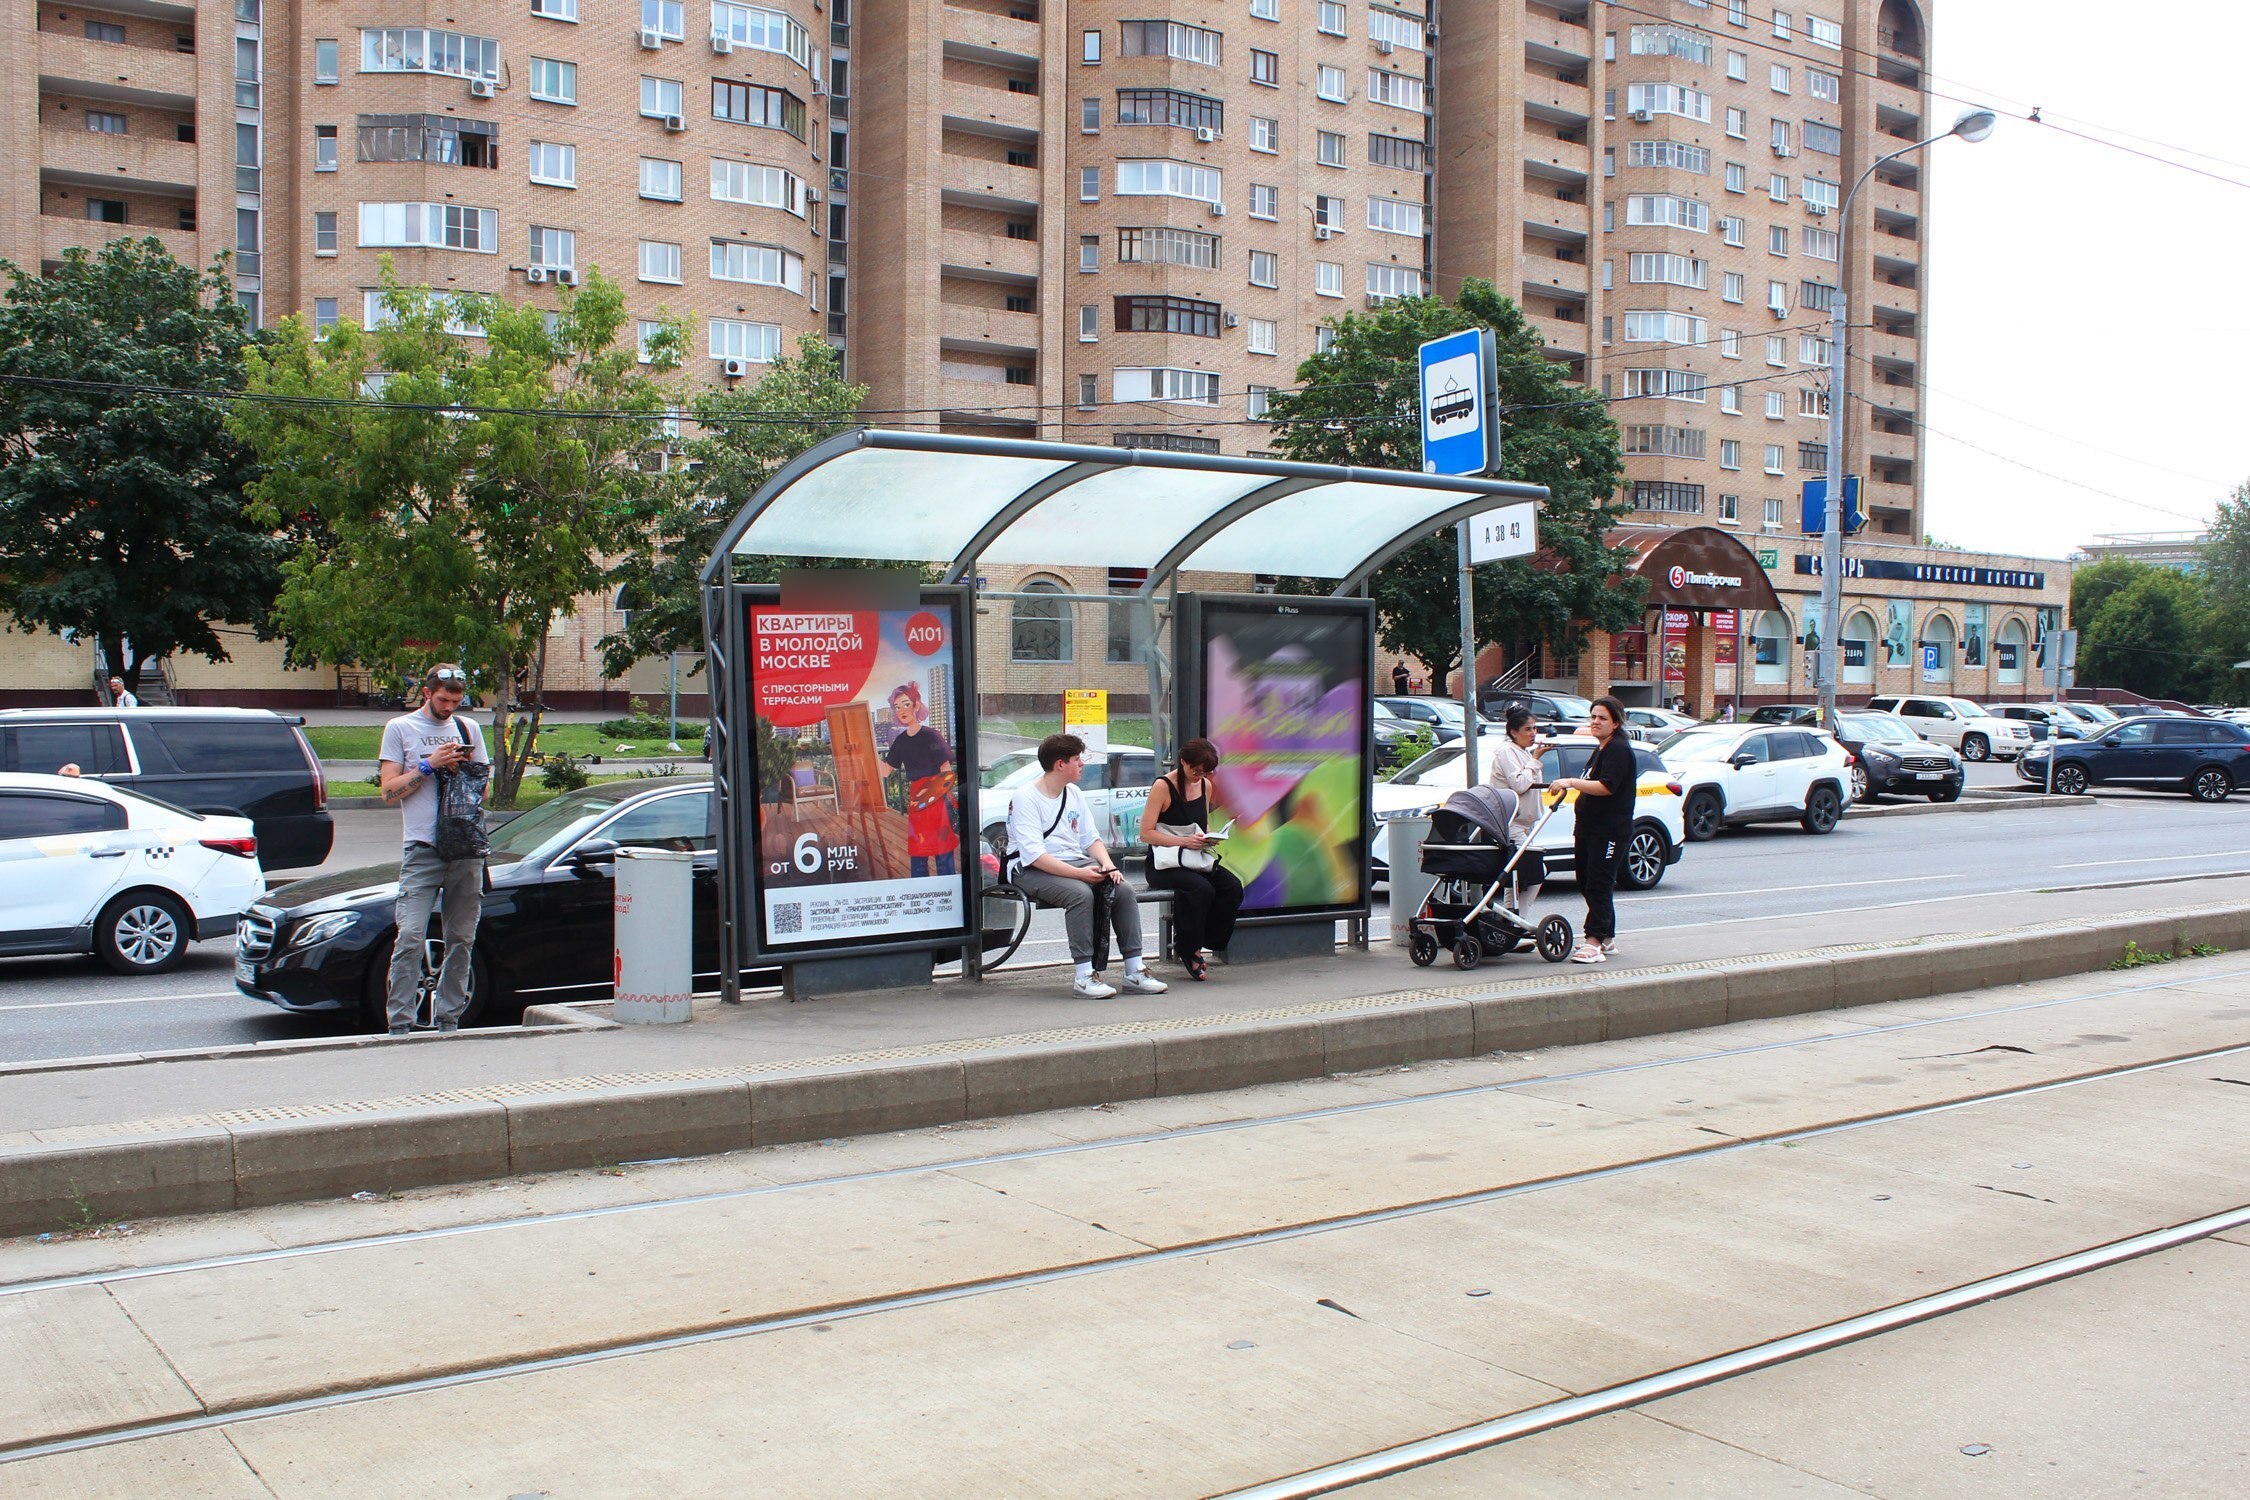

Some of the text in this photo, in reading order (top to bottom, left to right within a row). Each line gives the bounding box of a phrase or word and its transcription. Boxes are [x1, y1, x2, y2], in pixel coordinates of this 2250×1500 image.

[1495, 525, 1505, 541] 38
[1510, 522, 1520, 539] 43
[1762, 556, 1773, 566] 24
[1811, 555, 2035, 587] САРЬ МУЖСКОЙ КОСТЮМ
[759, 617, 851, 631] КВАРТИРЫ
[1665, 613, 1688, 621] СКОРО
[760, 633, 863, 653] В МОЛОДОЙ
[1845, 649, 1863, 657] УДАРЬ
[1926, 649, 1935, 667] P
[760, 654, 831, 669] МОСКВЕ
[762, 683, 849, 694] С ПРОСТОРНЫМИ
[762, 696, 822, 706] ТЕРРАСАМИ
[420, 735, 463, 746] VERSACE
[793, 832, 822, 874] 6
[827, 845, 858, 858] МЛН
[1605, 841, 1616, 859] ZARA
[828, 858, 858, 871] РУБ.
